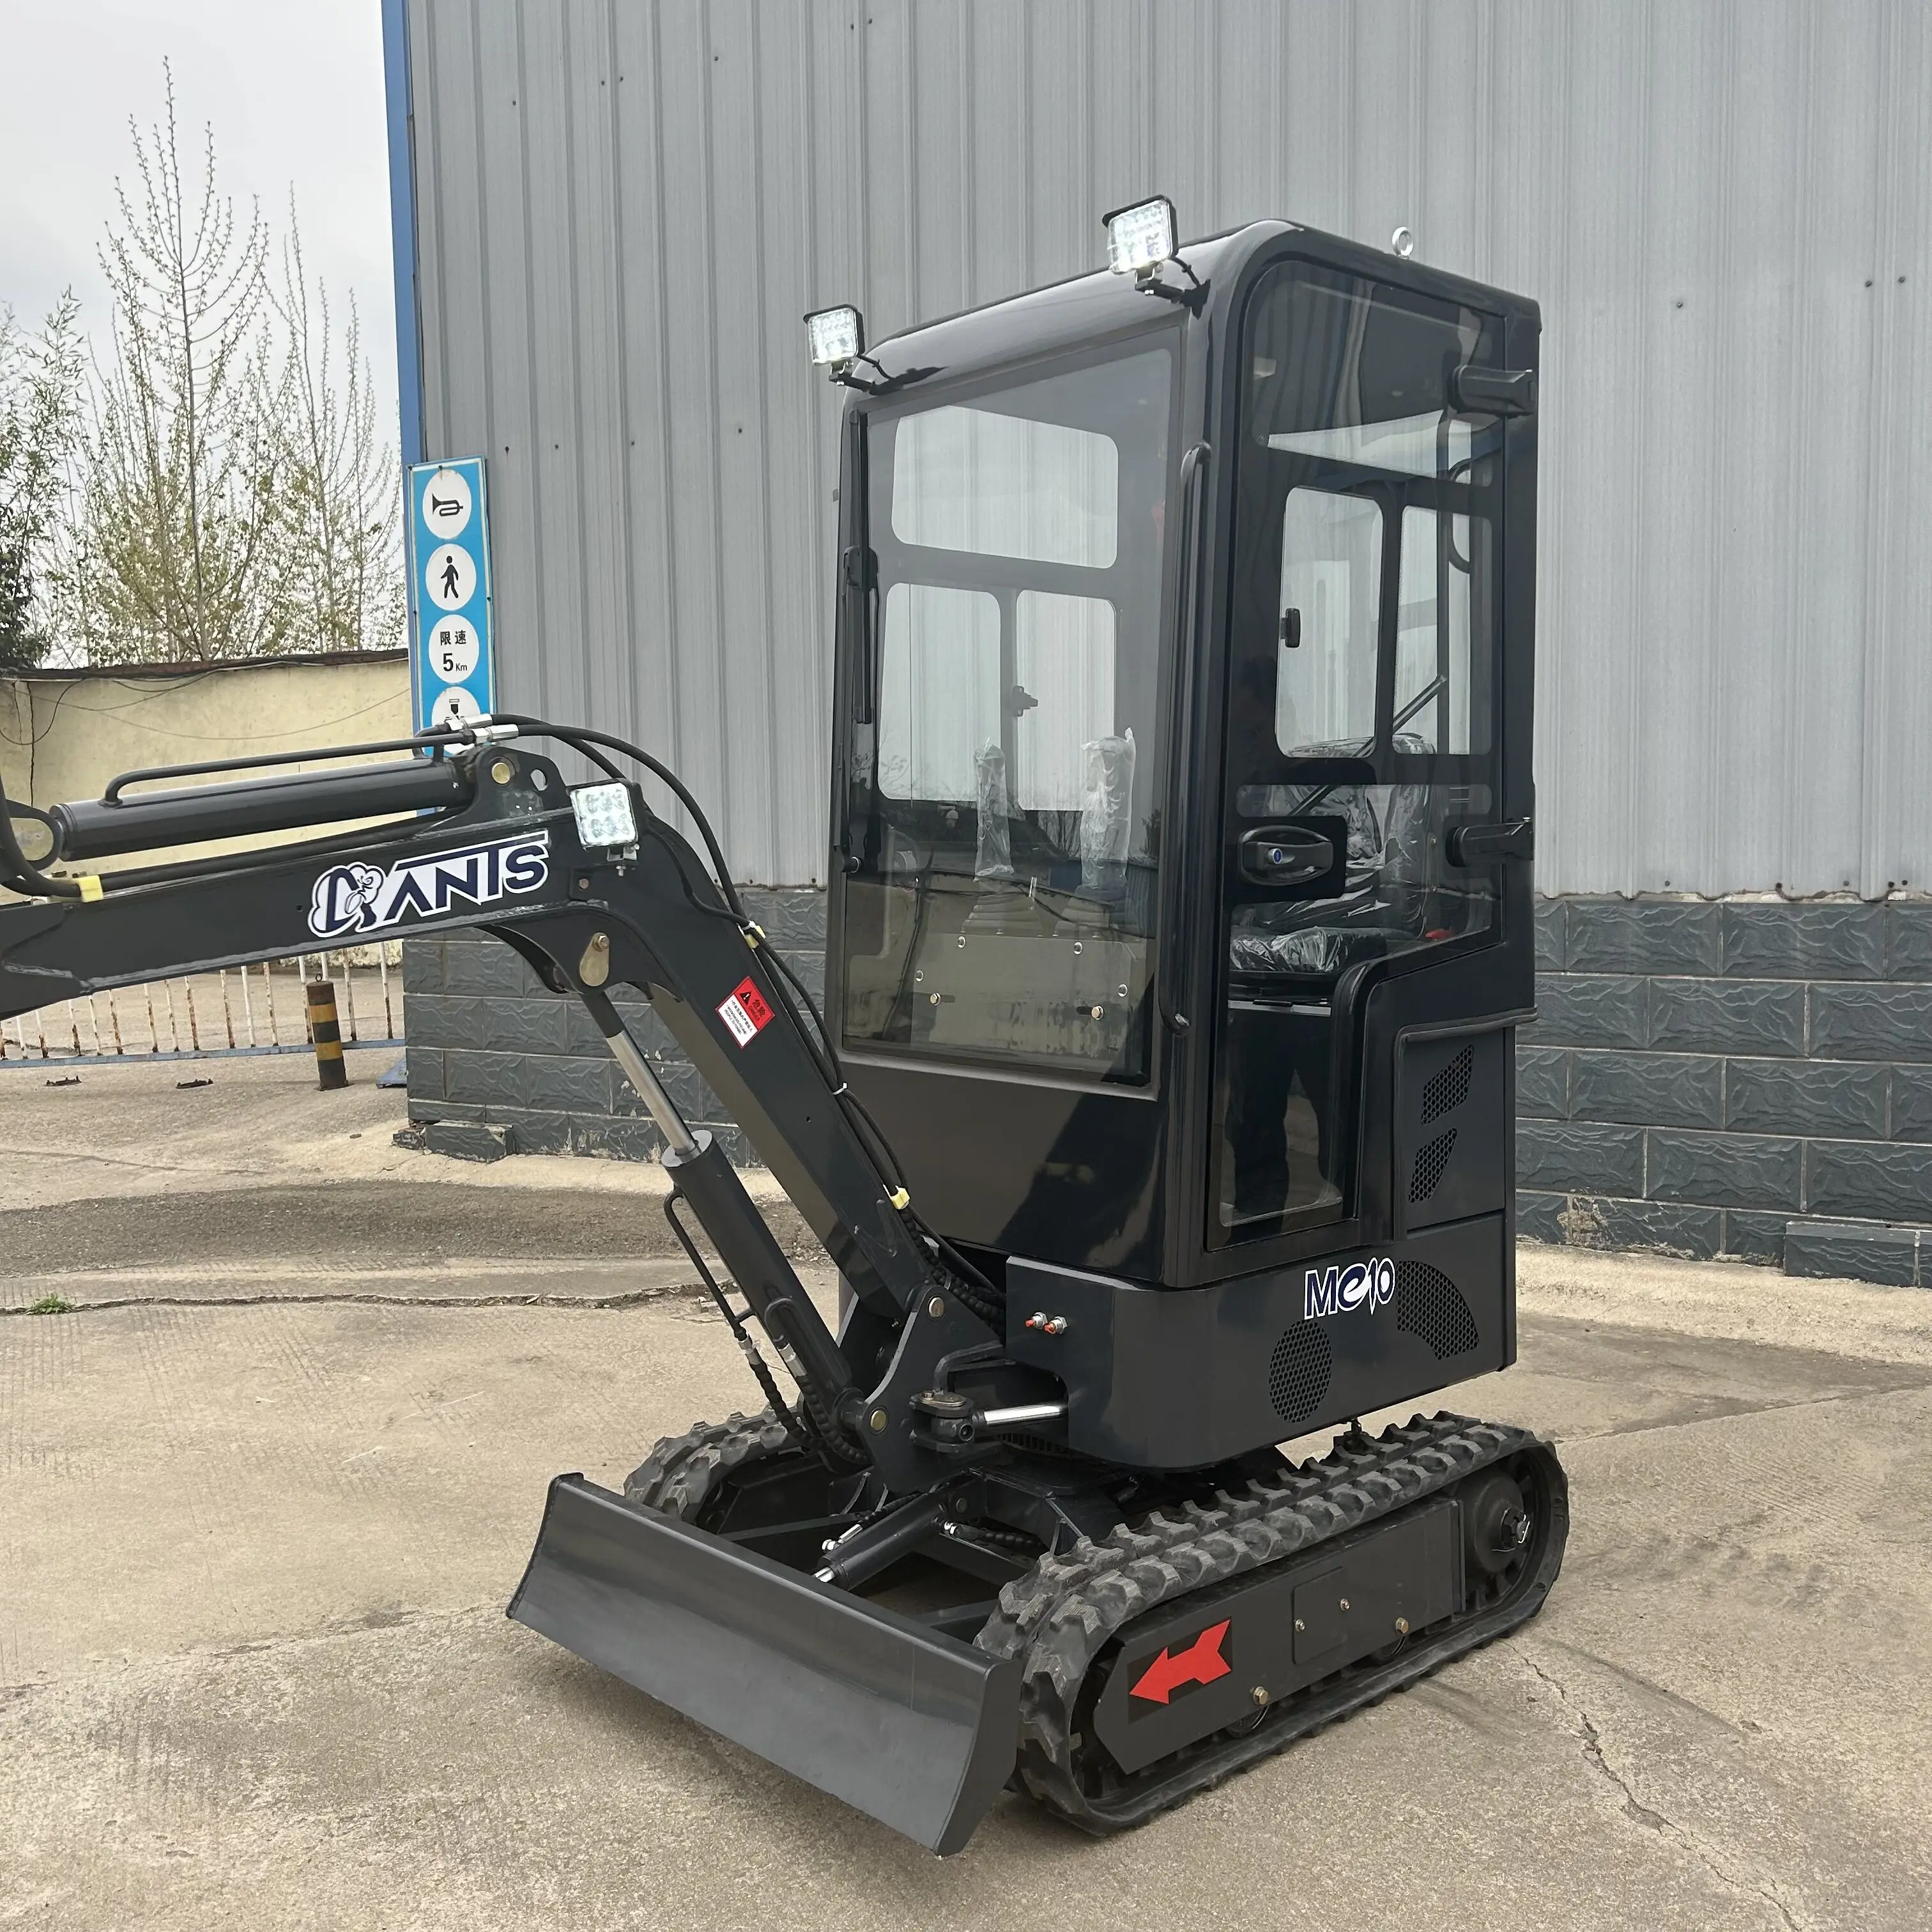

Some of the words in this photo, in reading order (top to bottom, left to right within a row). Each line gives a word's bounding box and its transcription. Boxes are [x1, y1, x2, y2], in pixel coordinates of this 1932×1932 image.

[440, 630, 467, 646] 限速
[443, 652, 454, 672] 5
[456, 663, 468, 671] Km
